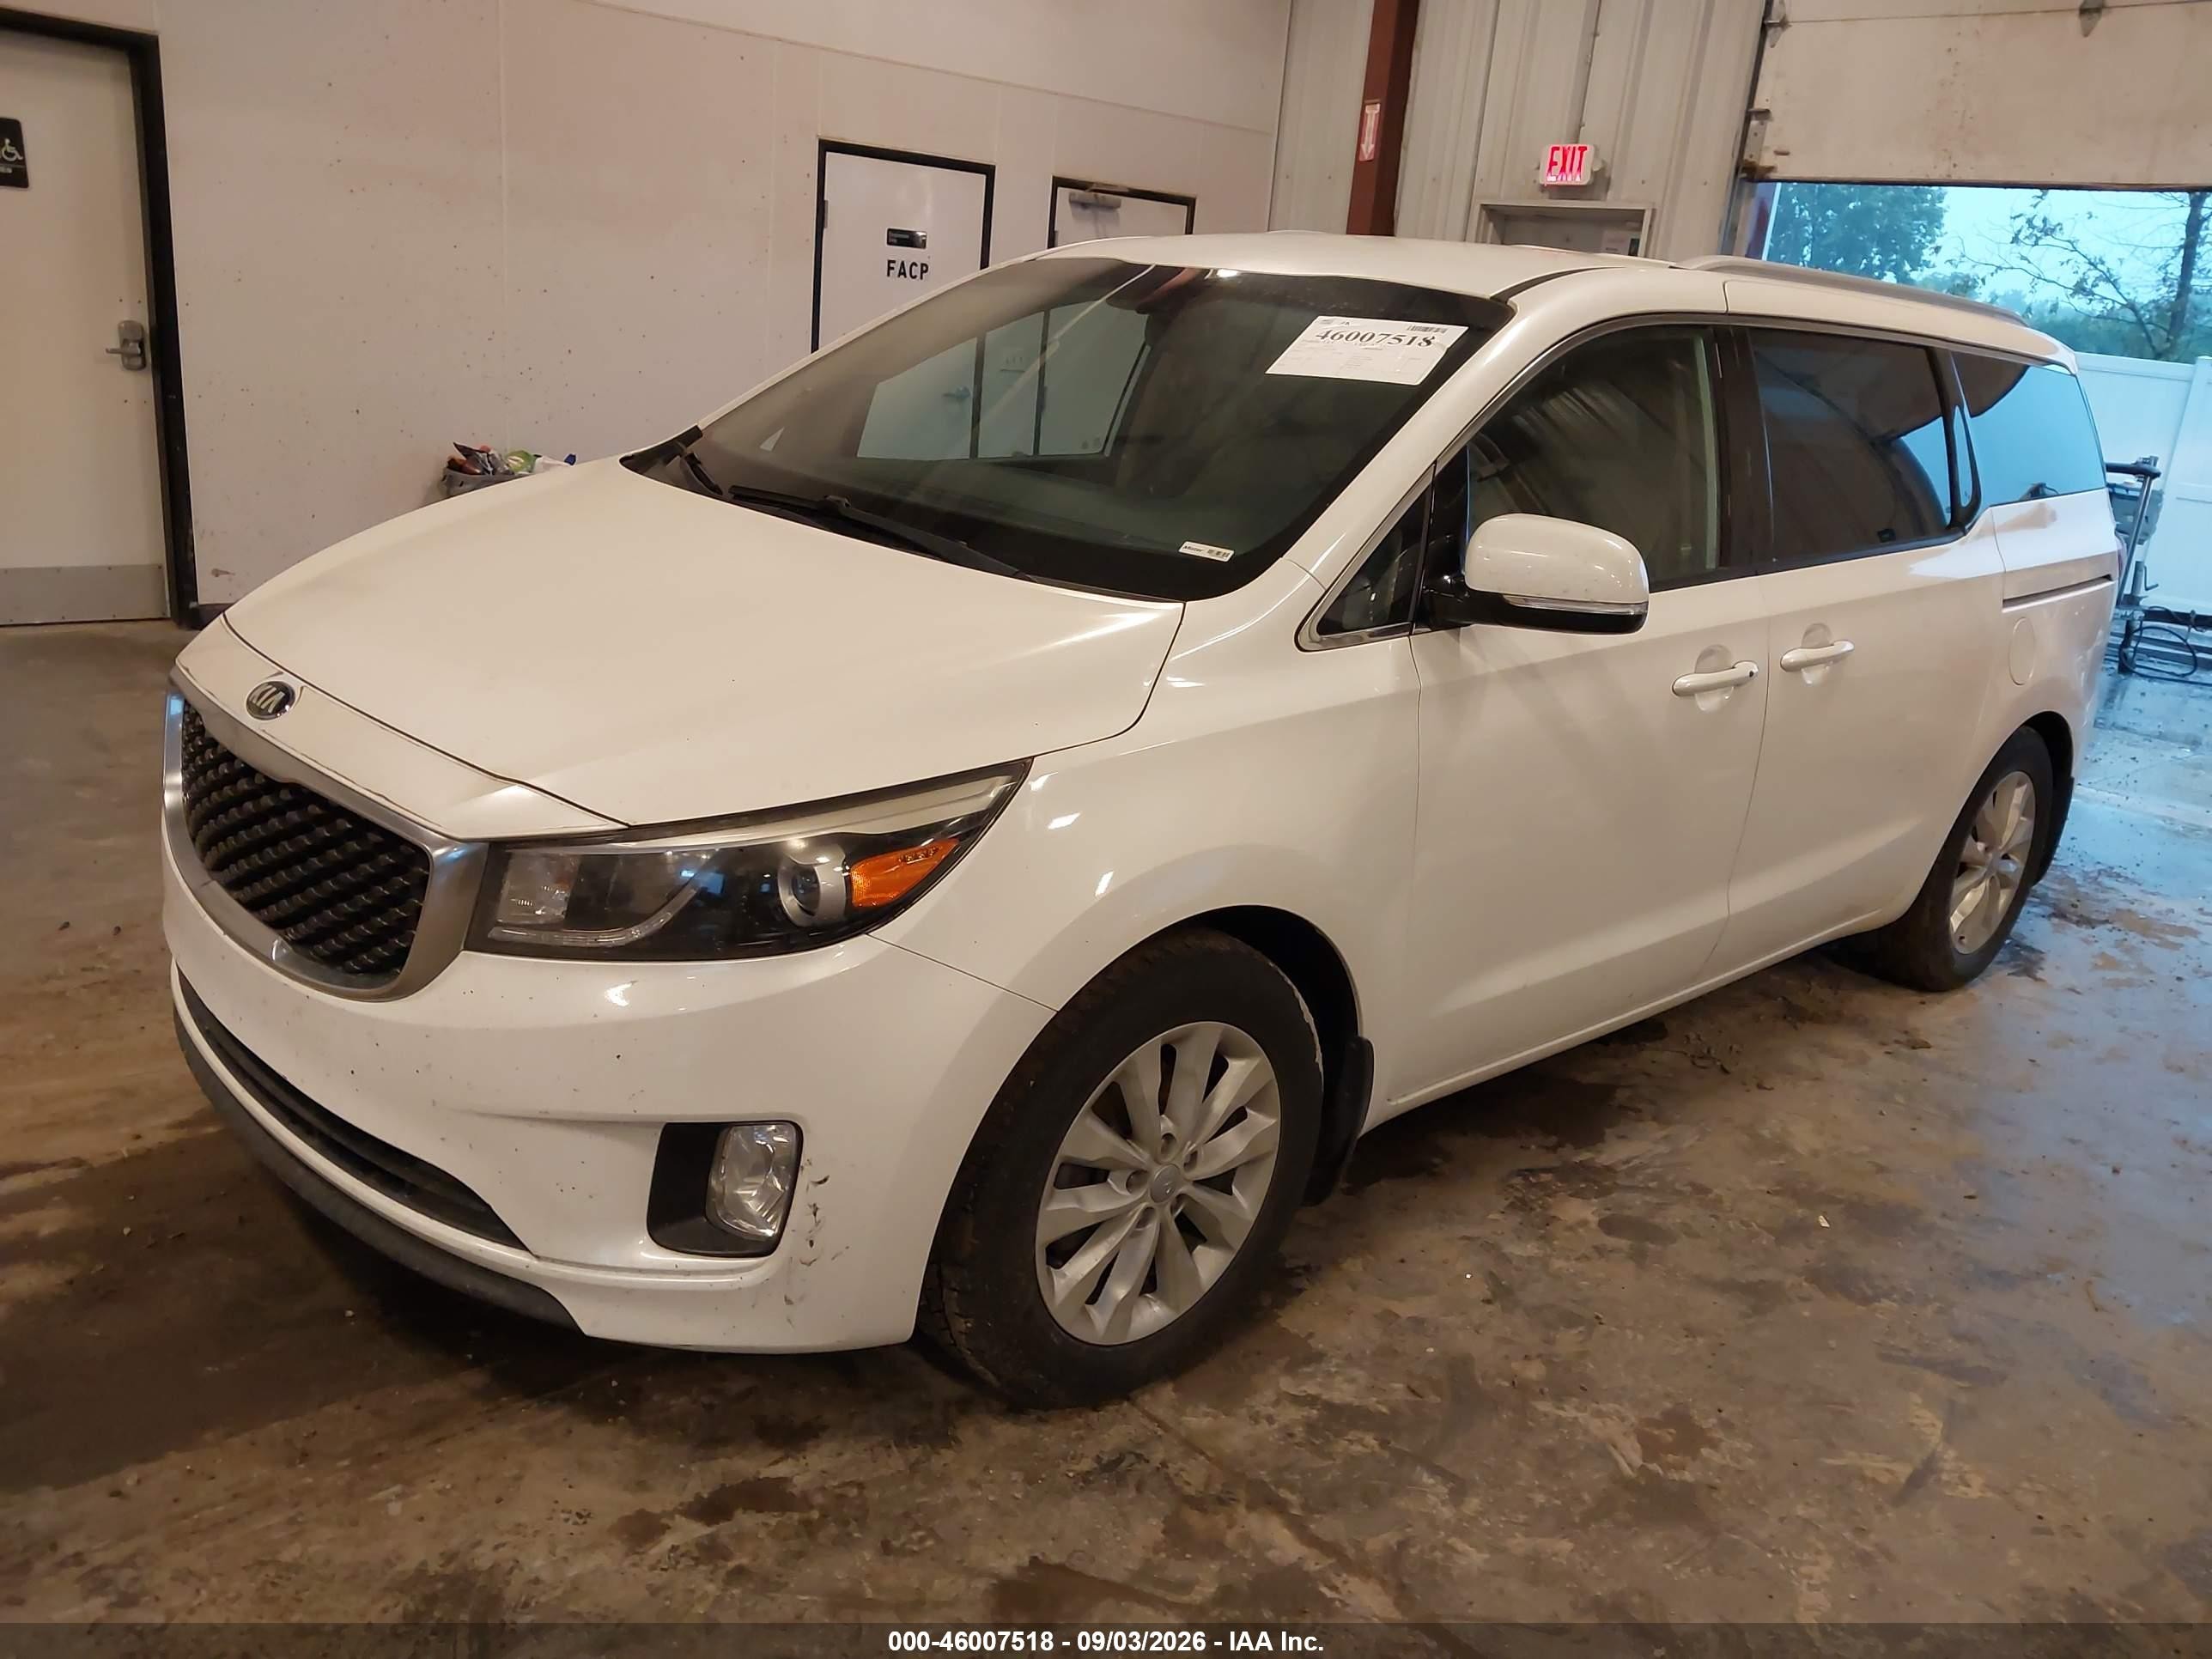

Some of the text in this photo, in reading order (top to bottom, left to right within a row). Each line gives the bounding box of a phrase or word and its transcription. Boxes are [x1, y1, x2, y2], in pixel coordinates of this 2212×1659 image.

[1547, 146, 1588, 181] EXIT
[887, 259, 928, 280] FACP
[1316, 330, 1436, 347] 46007518
